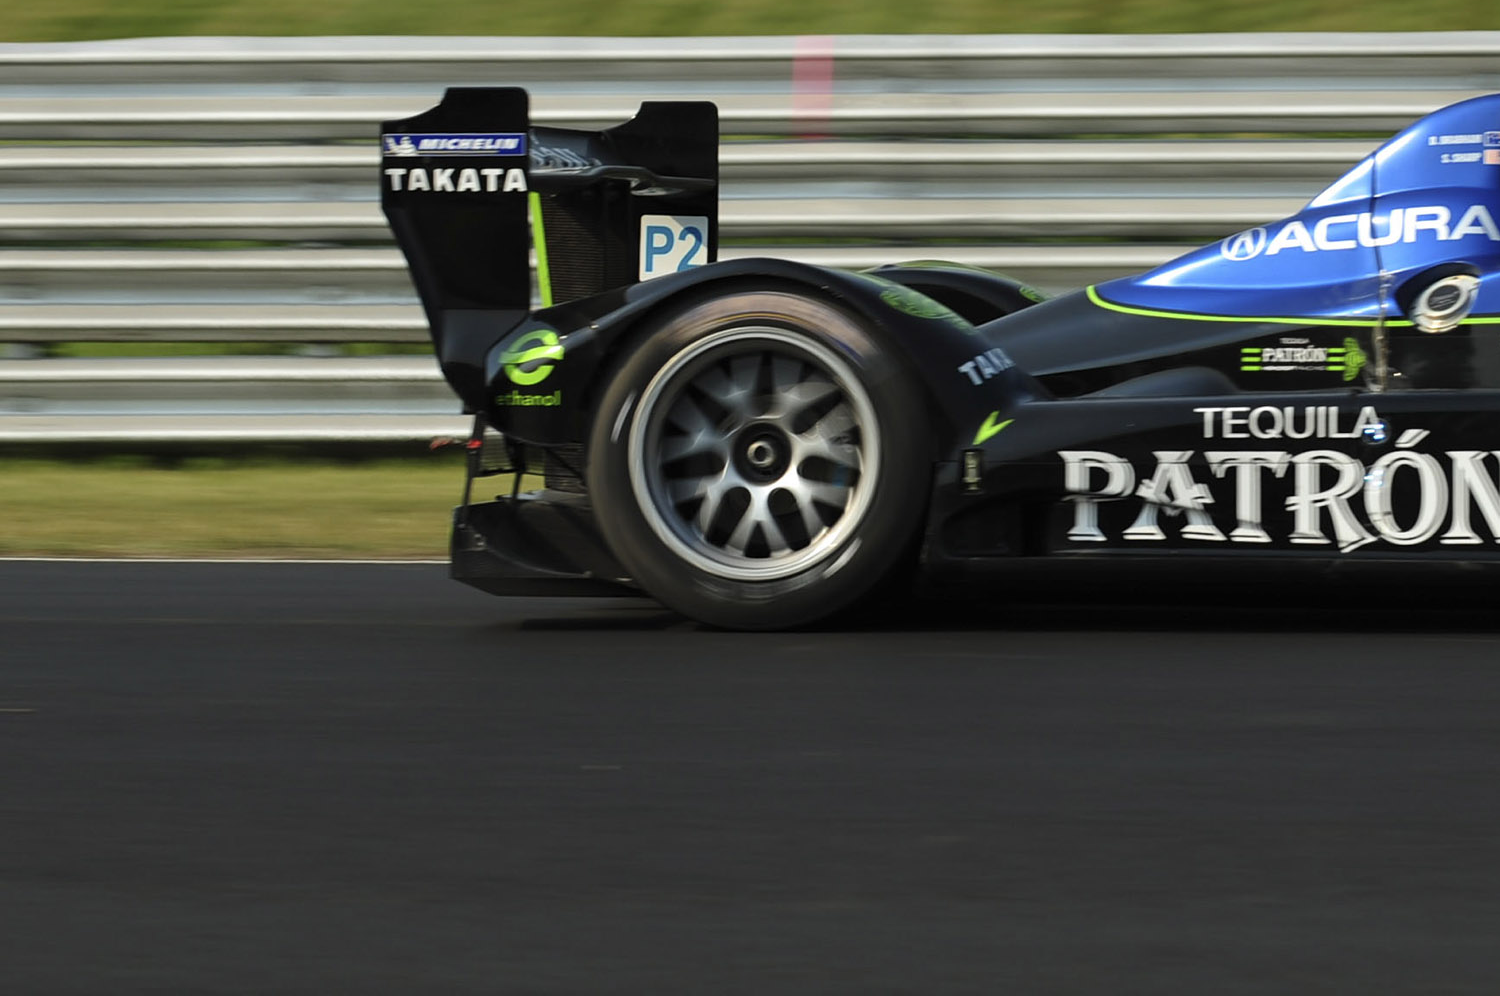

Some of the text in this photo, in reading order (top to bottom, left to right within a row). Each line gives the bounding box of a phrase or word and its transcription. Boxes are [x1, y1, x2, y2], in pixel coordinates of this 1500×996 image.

[418, 138, 520, 150] MICHELIN
[384, 168, 528, 192] TAKATA
[645, 225, 703, 273] P2
[1193, 406, 1378, 439] TEQUILA
